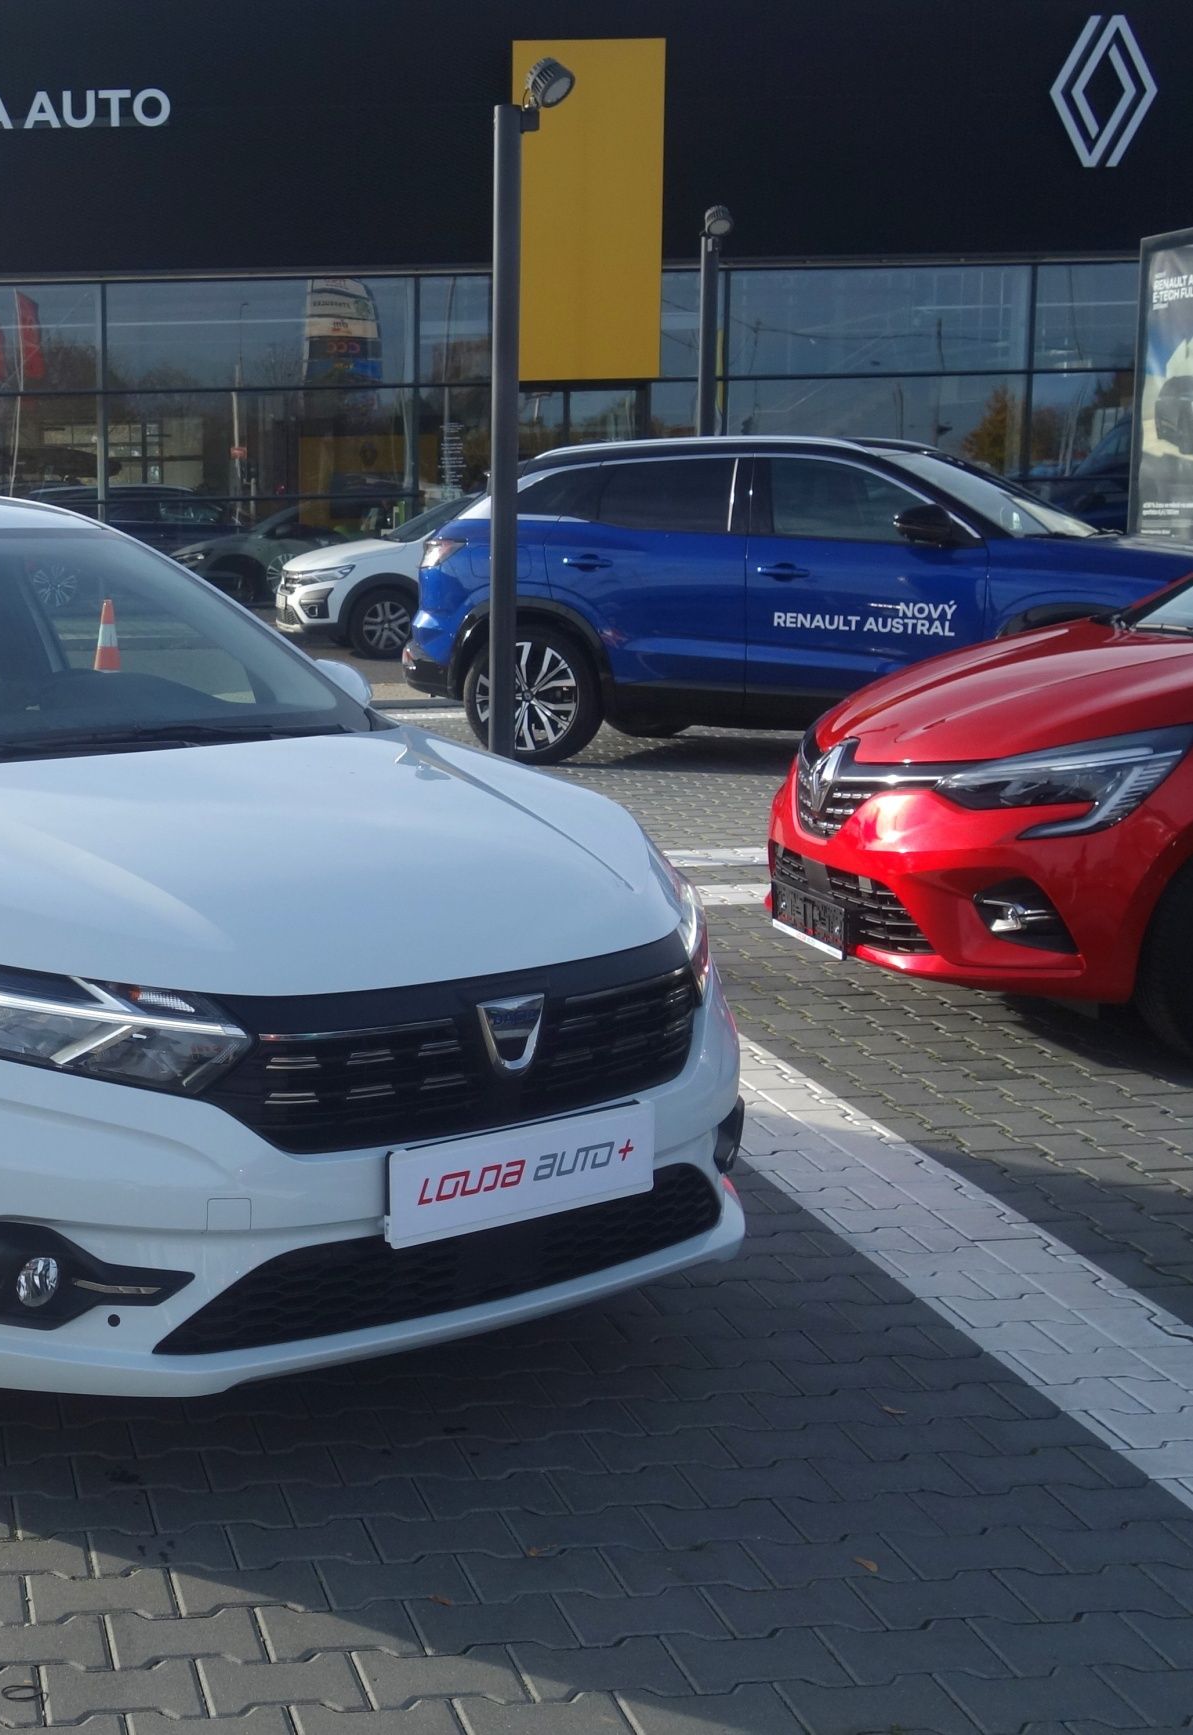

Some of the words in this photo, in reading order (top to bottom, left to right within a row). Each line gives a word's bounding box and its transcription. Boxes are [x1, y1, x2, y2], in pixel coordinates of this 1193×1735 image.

[23, 87, 171, 129] AUTO
[1153, 275, 1188, 291] RENAULT
[1152, 289, 1179, 303] E-TECH
[898, 600, 957, 620] NOVÝ
[773, 611, 860, 631] RENAULT
[863, 616, 955, 636] AUSTRAL
